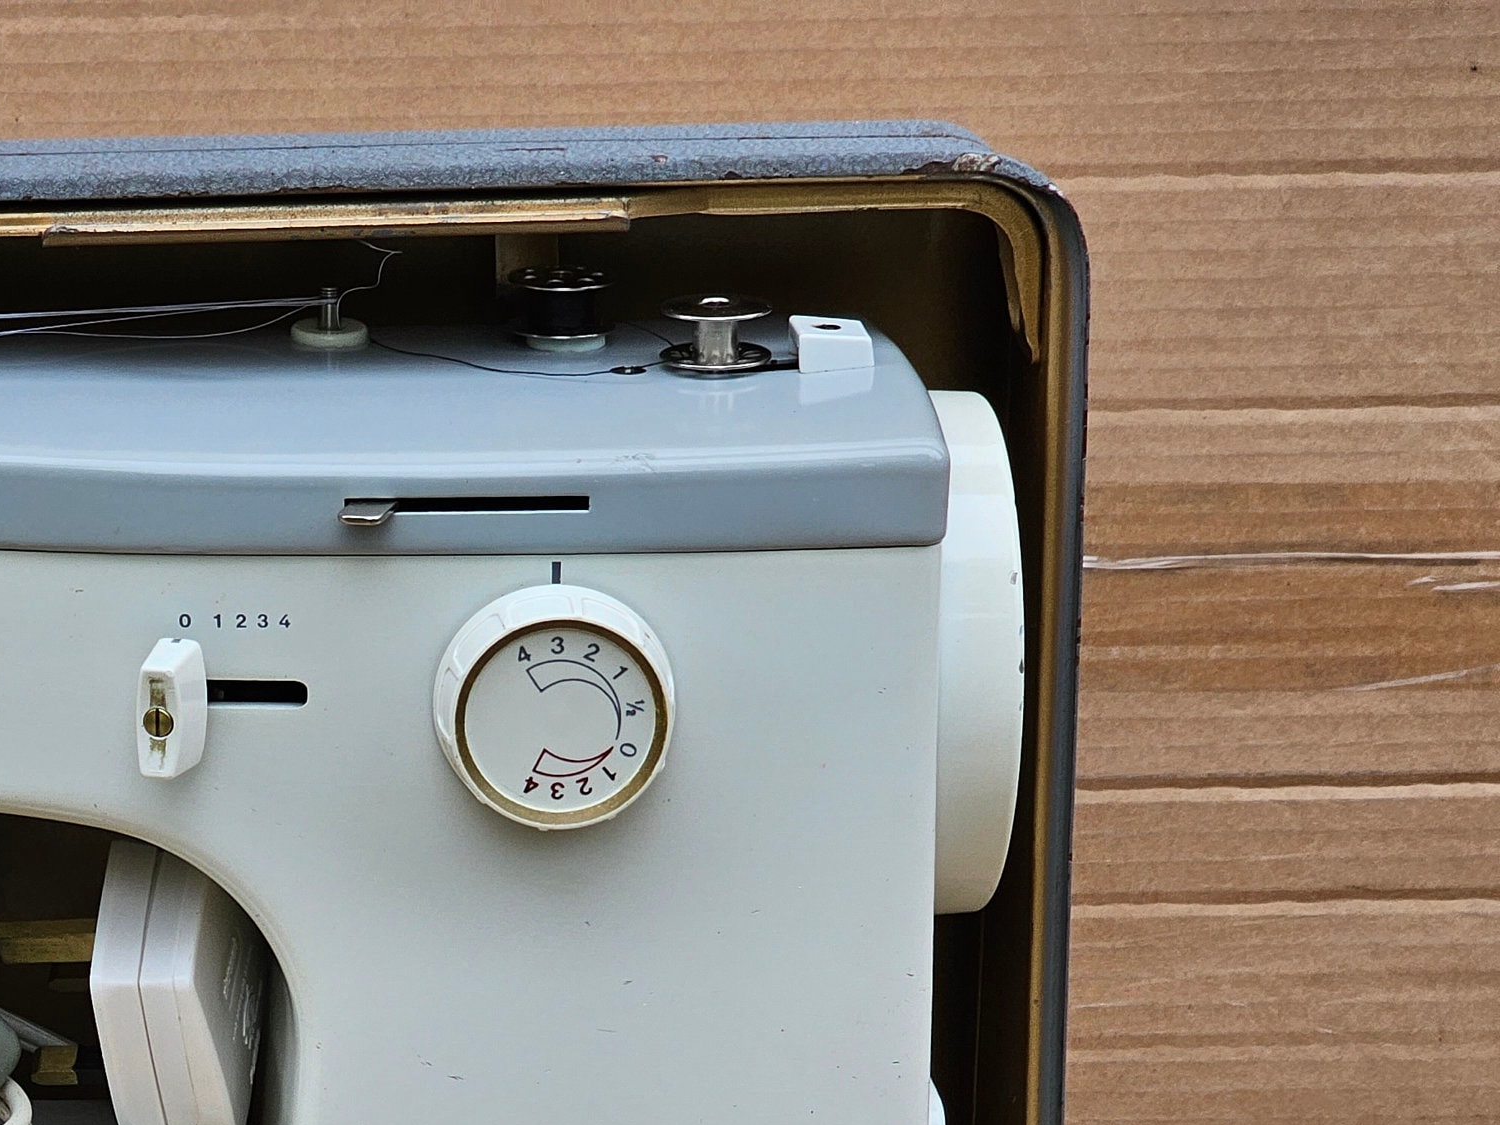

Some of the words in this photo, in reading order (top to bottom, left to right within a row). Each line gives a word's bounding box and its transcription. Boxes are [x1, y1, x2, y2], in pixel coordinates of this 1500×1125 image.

[178, 613, 192, 629] 0
[212, 613, 222, 629] 1
[235, 613, 247, 629] 2
[257, 613, 269, 629] 3
[278, 613, 291, 629] 4
[517, 645, 532, 662] 4
[550, 635, 565, 655] 3
[582, 642, 601, 663] 2
[612, 665, 629, 680] 1
[619, 742, 638, 758] 0
[601, 766, 617, 782] 1
[522, 776, 540, 794] 4
[550, 781, 565, 801] 3
[575, 776, 593, 796] 2
